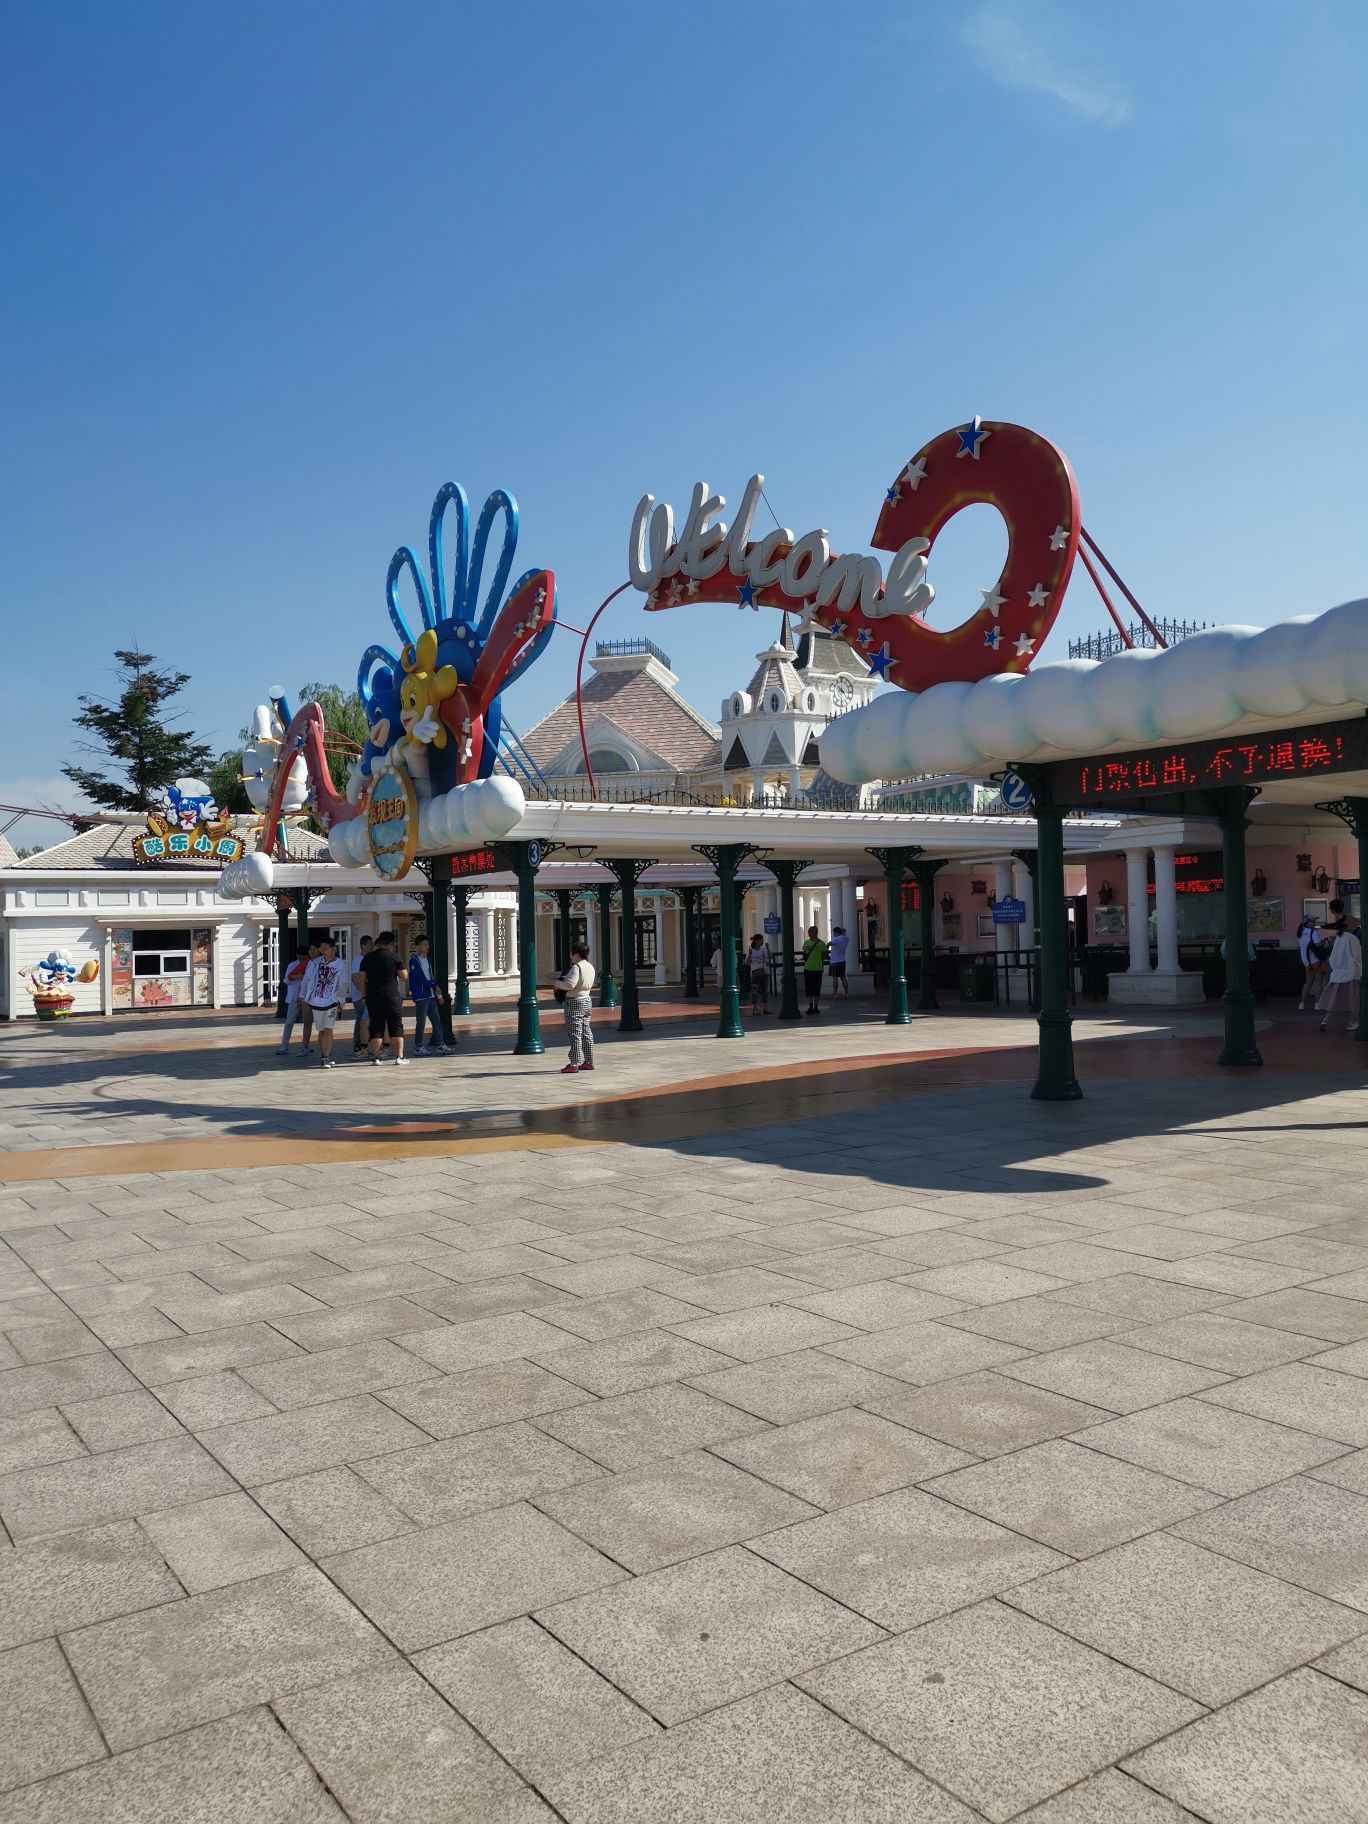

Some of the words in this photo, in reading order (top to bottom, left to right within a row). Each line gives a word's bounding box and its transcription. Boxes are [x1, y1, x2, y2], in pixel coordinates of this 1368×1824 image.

[629, 473, 935, 618] Welcome
[1008, 775, 1025, 803] 2
[142, 833, 237, 857] 酷乐小厨
[531, 842, 539, 859] 3
